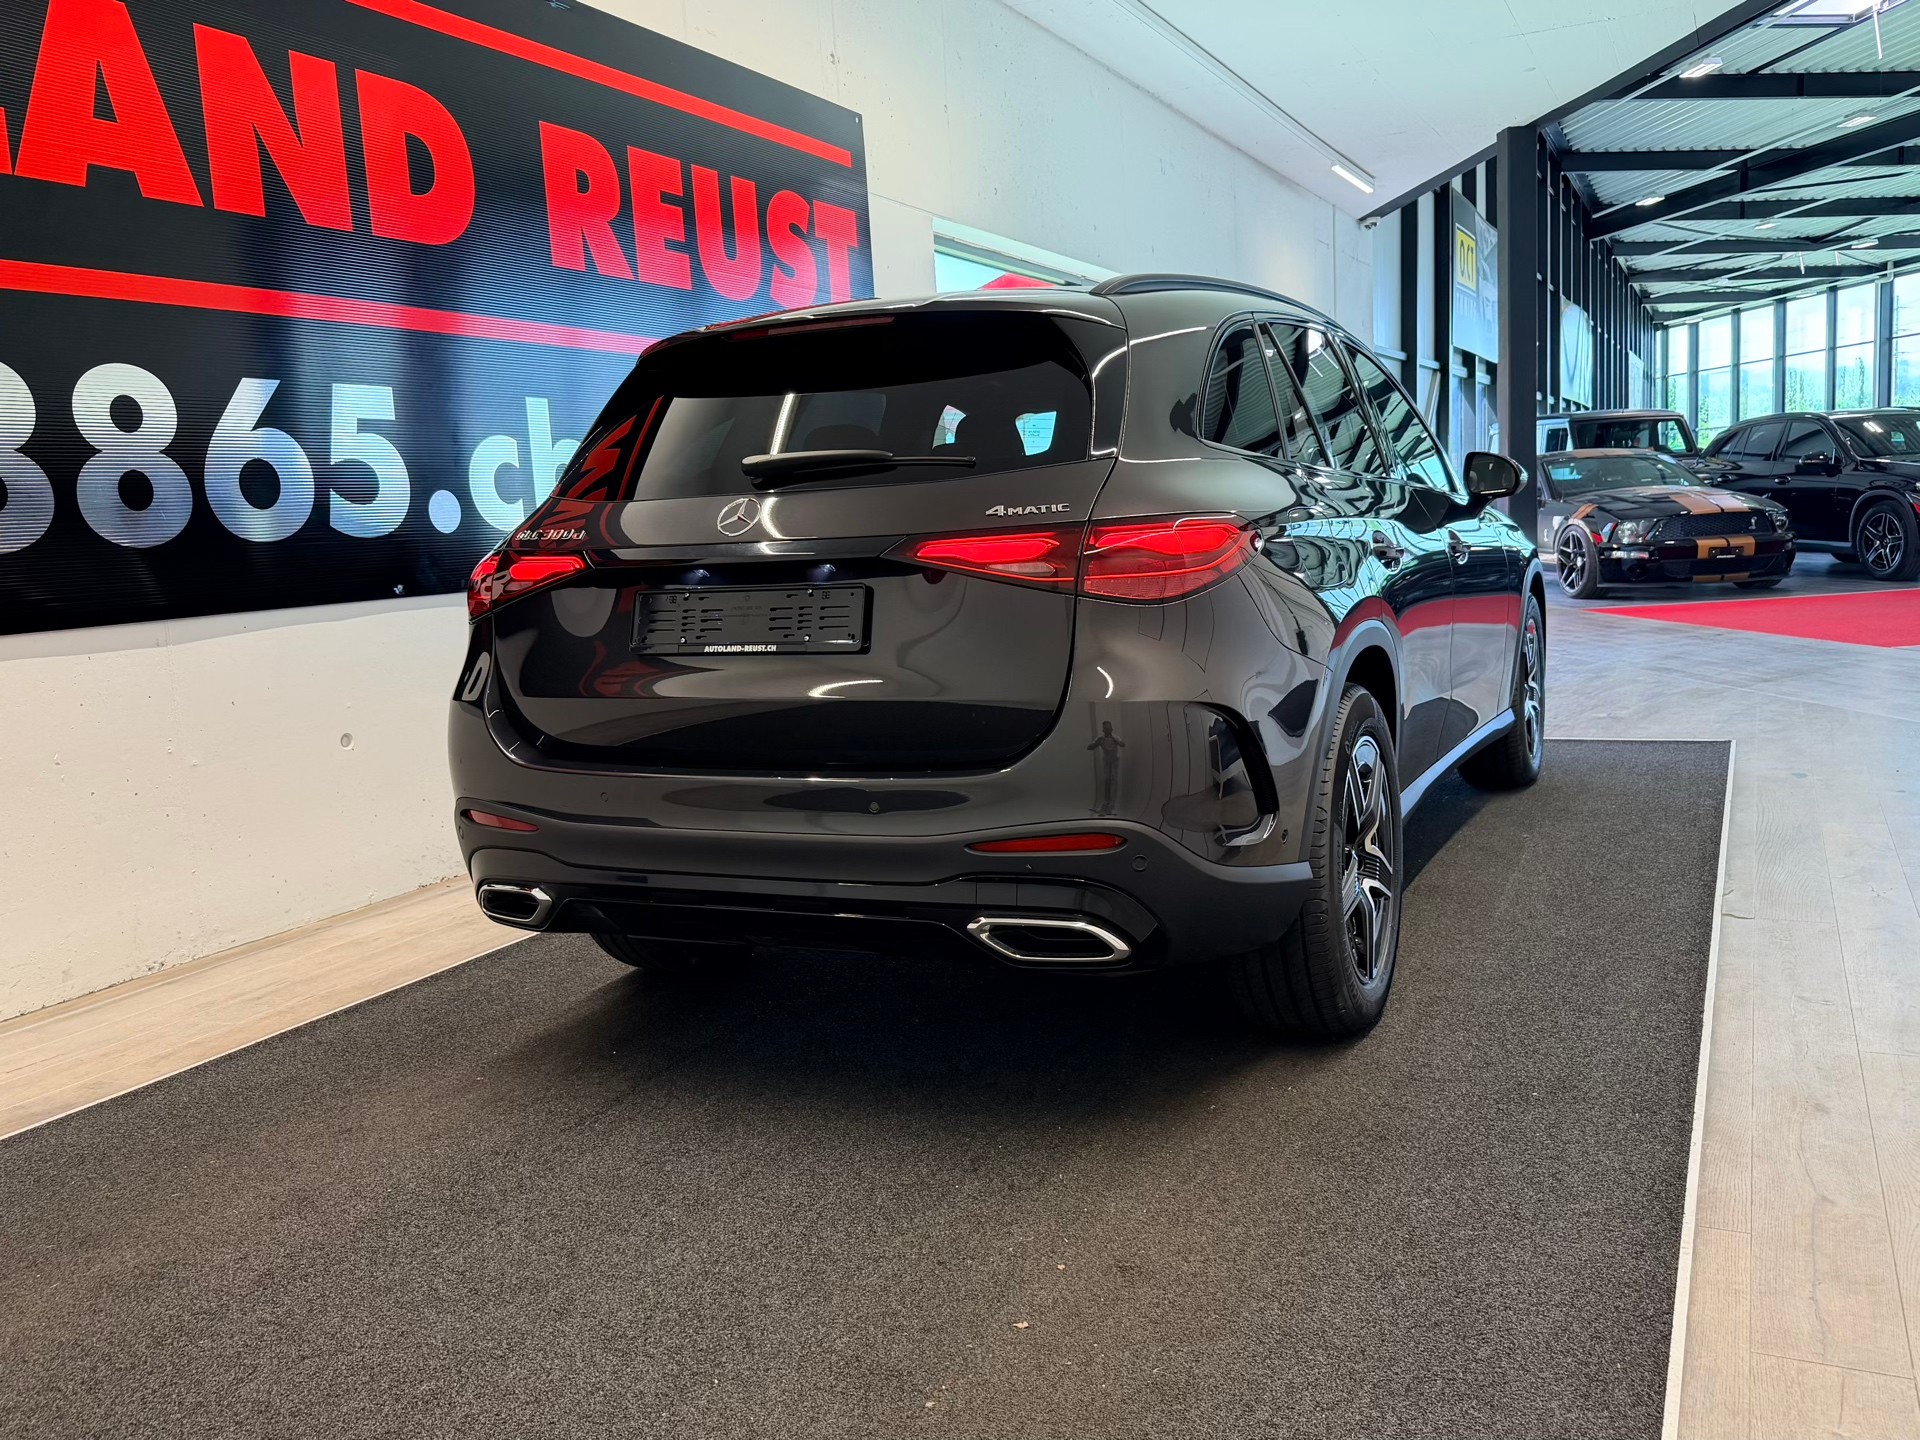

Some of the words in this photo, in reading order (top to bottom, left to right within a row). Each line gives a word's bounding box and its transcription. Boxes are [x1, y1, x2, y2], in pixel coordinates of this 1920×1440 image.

[0, 0, 475, 246] AND
[538, 120, 858, 309] REUST
[985, 503, 1070, 516] 4MATIC
[704, 644, 777, 653] AUTOLAND-REUST.CH
